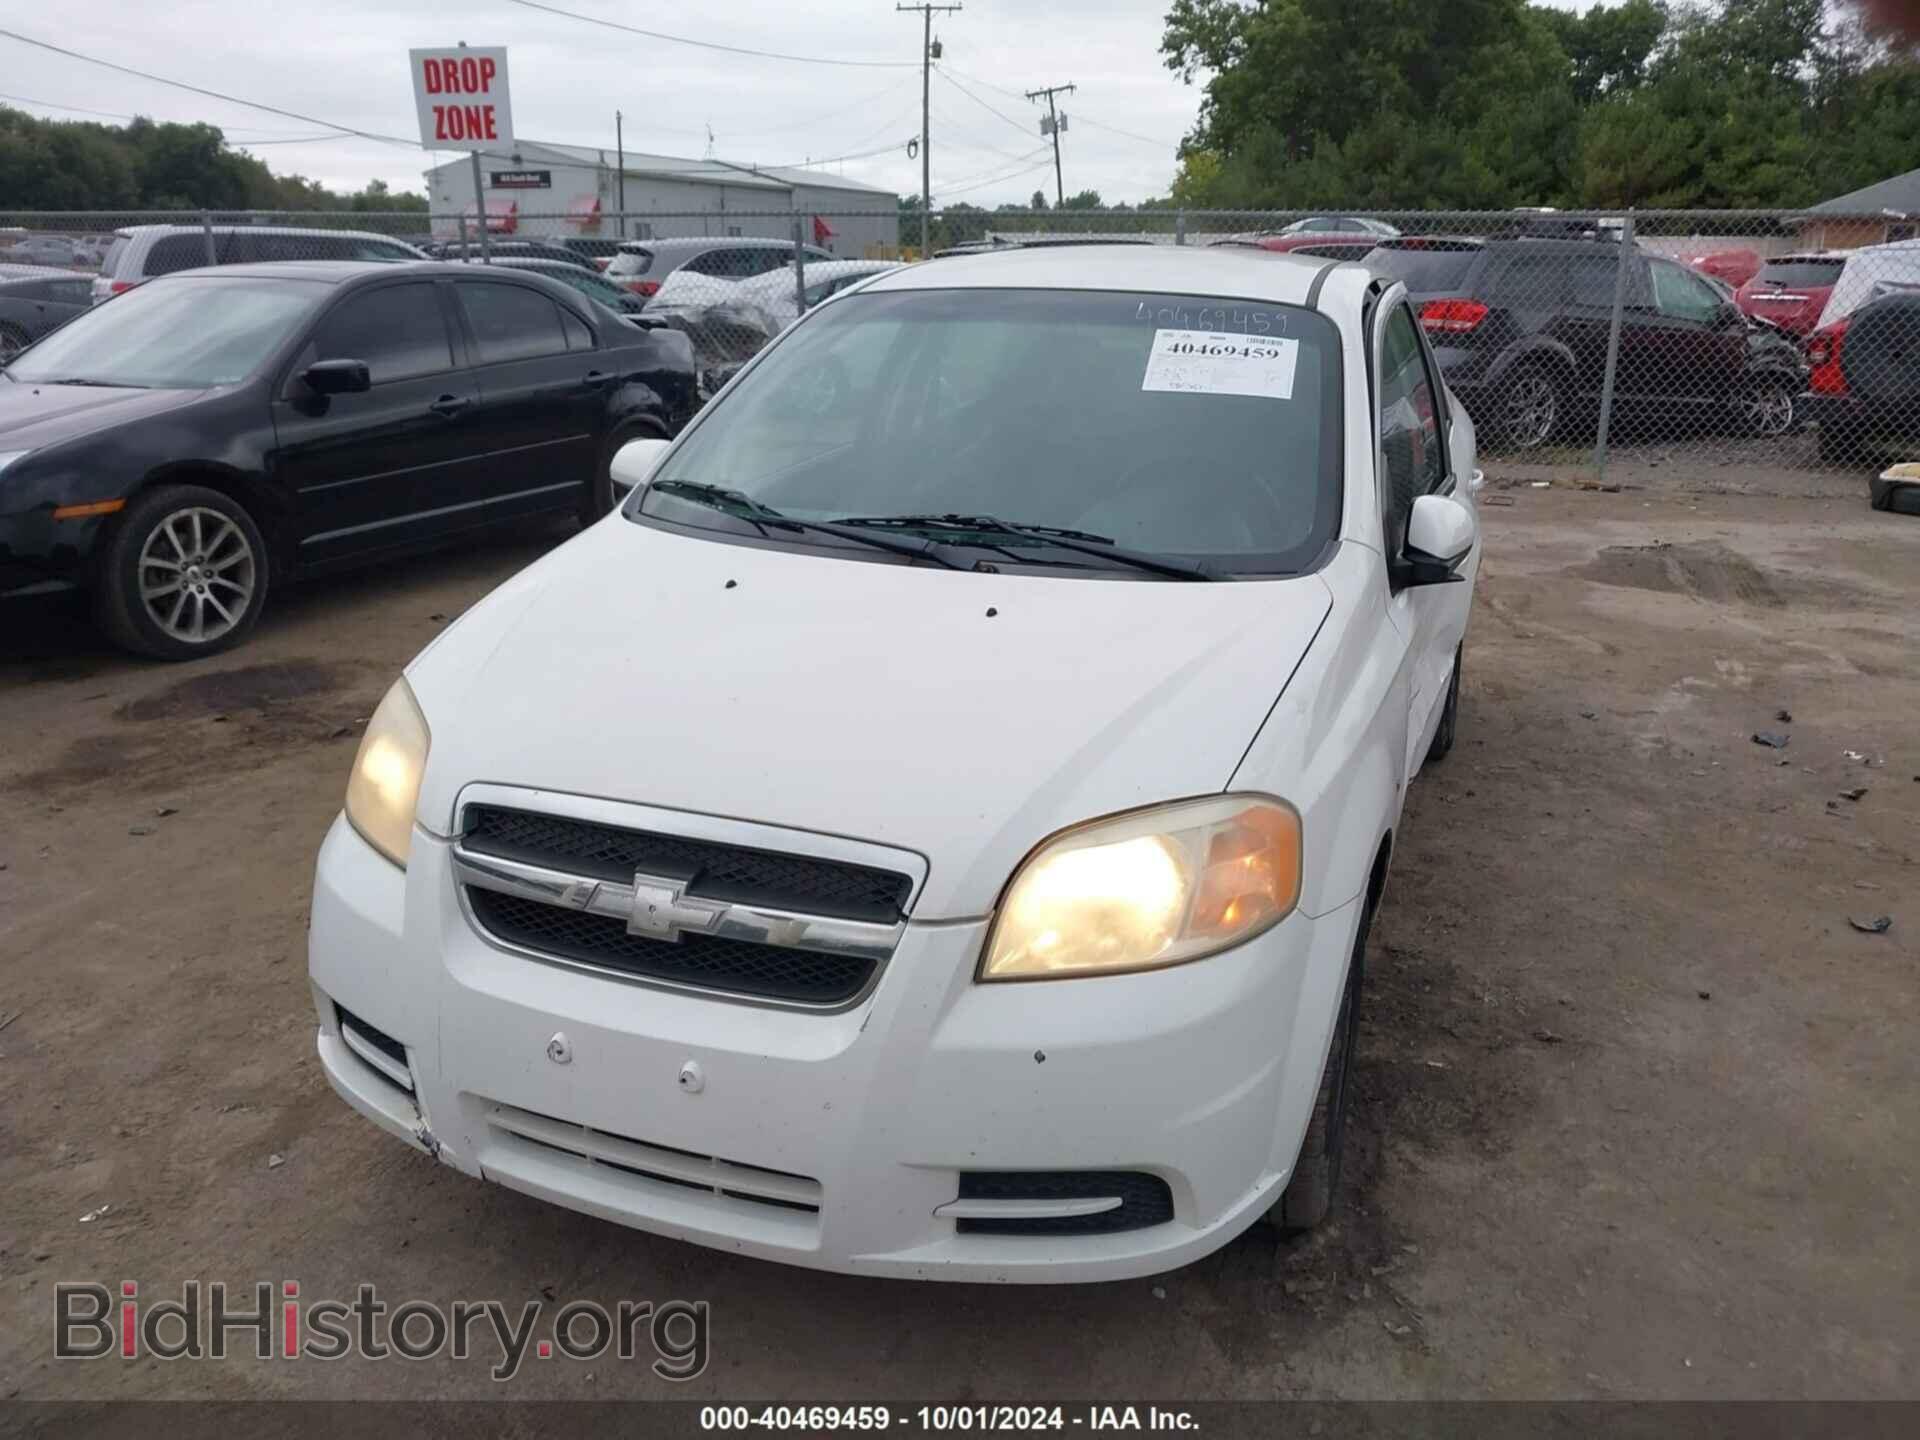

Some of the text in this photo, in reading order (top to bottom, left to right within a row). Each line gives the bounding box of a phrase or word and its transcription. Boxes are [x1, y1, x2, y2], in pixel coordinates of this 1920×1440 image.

[423, 57, 496, 94] DROP
[432, 104, 498, 141] ZONE
[1135, 301, 1289, 333] 40469459
[1167, 342, 1280, 360] 40469459
